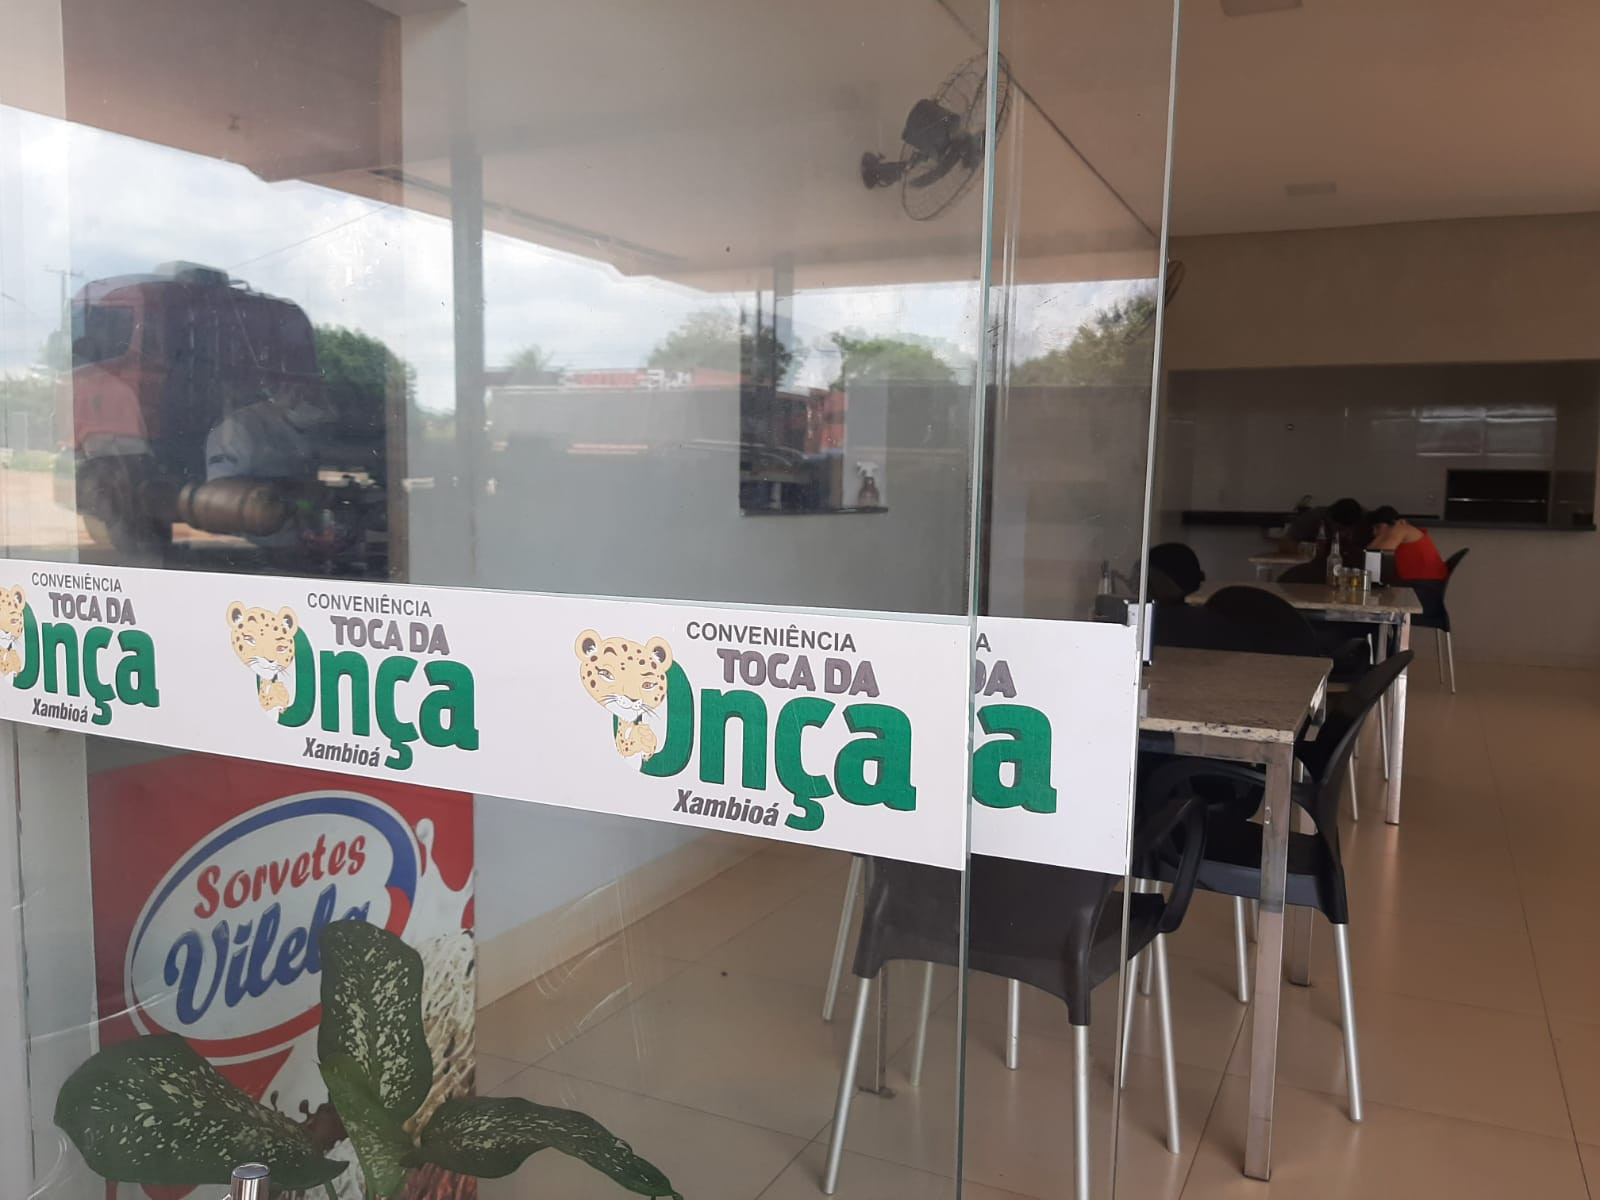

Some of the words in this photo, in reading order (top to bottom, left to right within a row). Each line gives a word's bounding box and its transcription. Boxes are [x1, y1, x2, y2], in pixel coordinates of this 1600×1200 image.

[31, 572, 122, 593] CONVENIÊNCIA
[49, 592, 103, 623] TOCA
[106, 597, 136, 625] DA
[307, 593, 432, 618] CONVENIÊNCIA
[331, 616, 404, 650] TOCA
[409, 622, 450, 655] DA
[686, 621, 857, 653] CONVENIÊNCIA
[717, 648, 816, 692] TOCA
[823, 659, 880, 698] DA
[32, 698, 88, 723] Xambioá
[302, 737, 381, 768] Xambioá
[672, 788, 779, 827] Xambioá
[194, 833, 366, 919] Sorvetes
